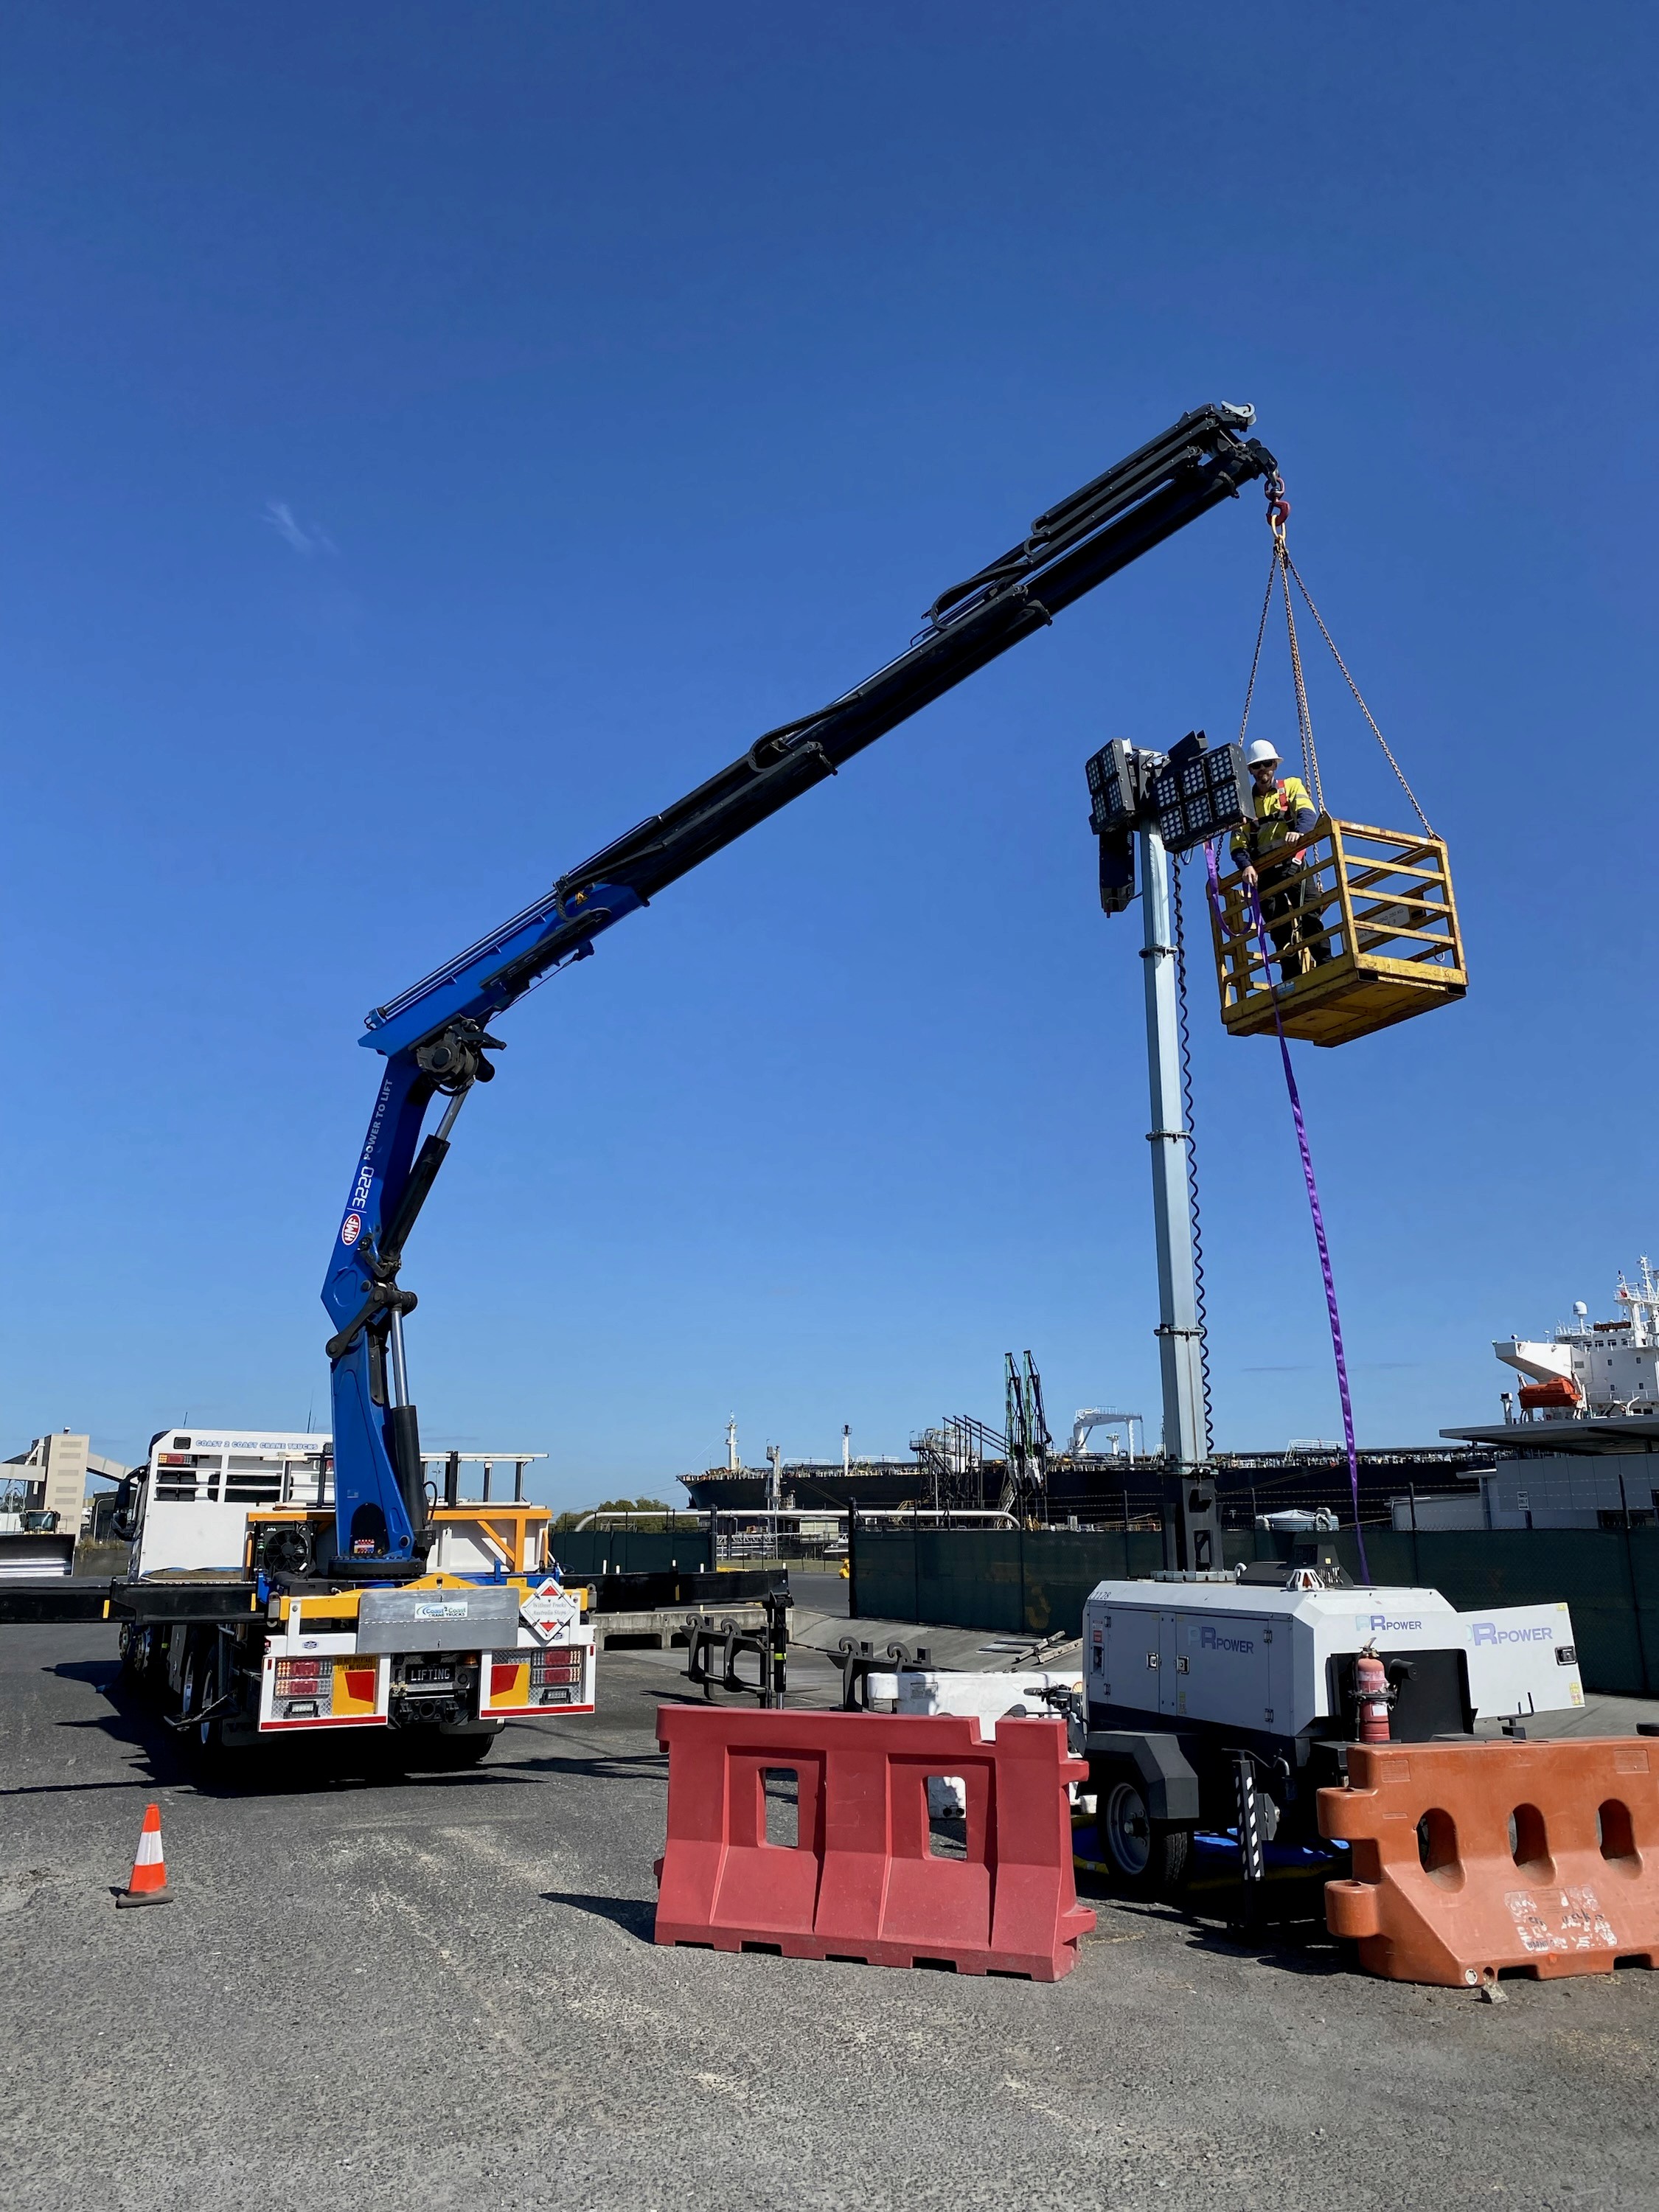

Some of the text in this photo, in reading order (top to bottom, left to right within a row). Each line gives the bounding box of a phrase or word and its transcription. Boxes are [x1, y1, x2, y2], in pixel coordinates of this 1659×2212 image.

[380, 1079, 393, 1102] LIFT
[375, 1103, 386, 1119] TO
[363, 1121, 381, 1161] POWER
[352, 1166, 375, 1209] 3220
[288, 1442, 319, 1450] TRUCKS
[411, 1668, 451, 1681] LIFTING
